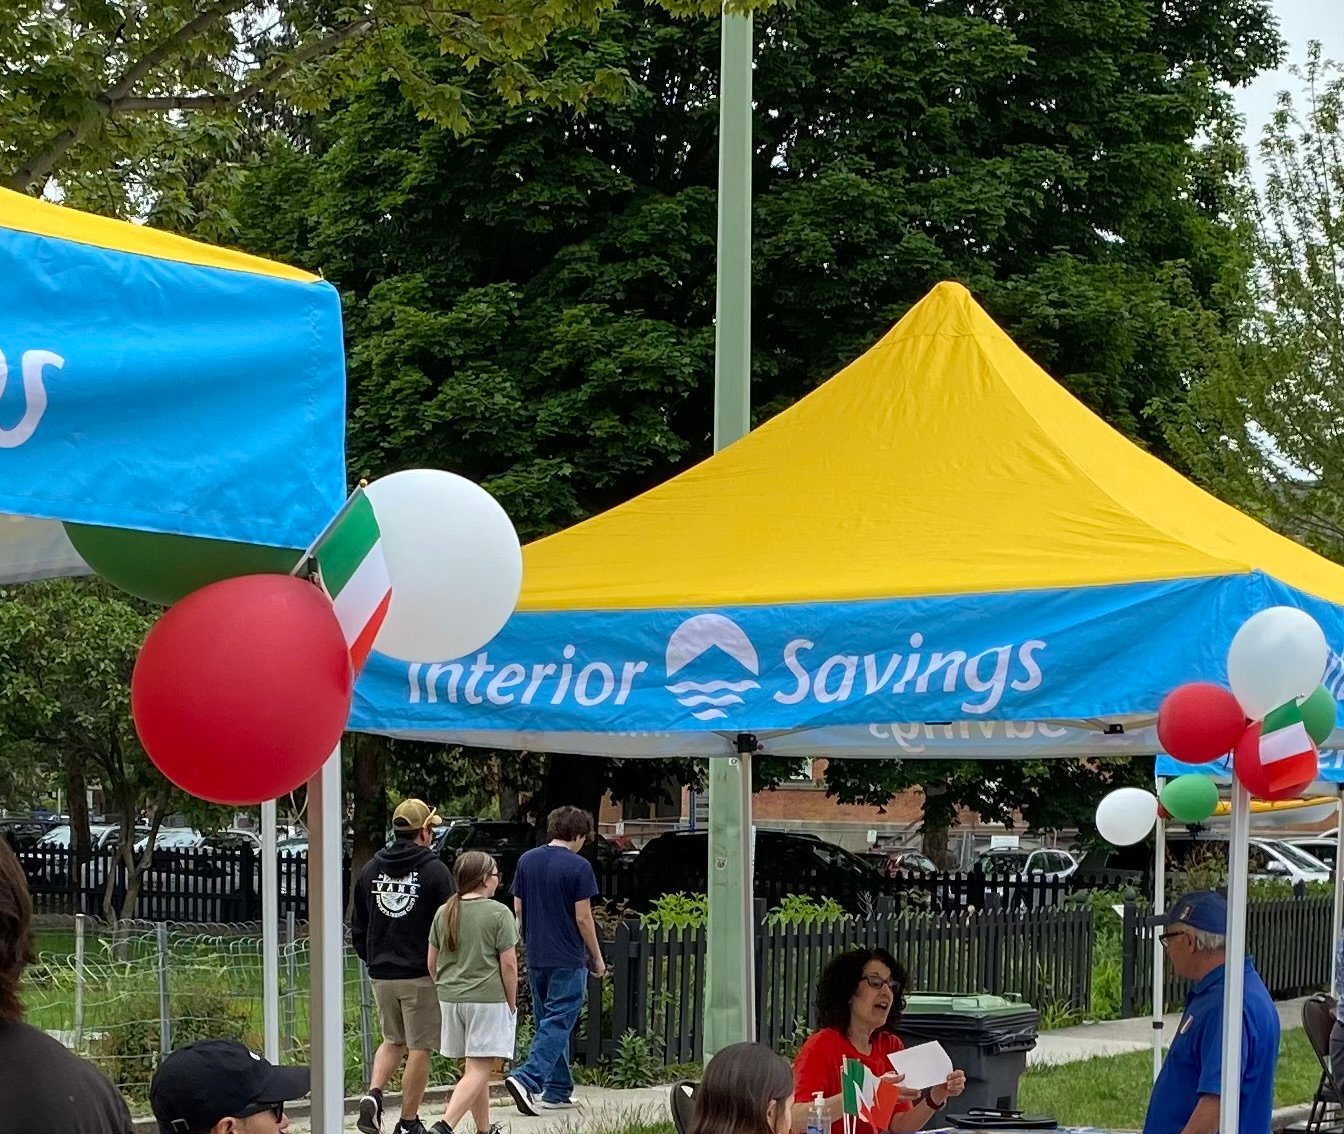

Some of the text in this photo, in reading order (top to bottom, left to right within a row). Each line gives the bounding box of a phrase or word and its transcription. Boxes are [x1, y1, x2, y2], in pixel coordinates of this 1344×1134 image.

[408, 632, 1047, 715] Interior Savings
[376, 882, 417, 895] VANS
